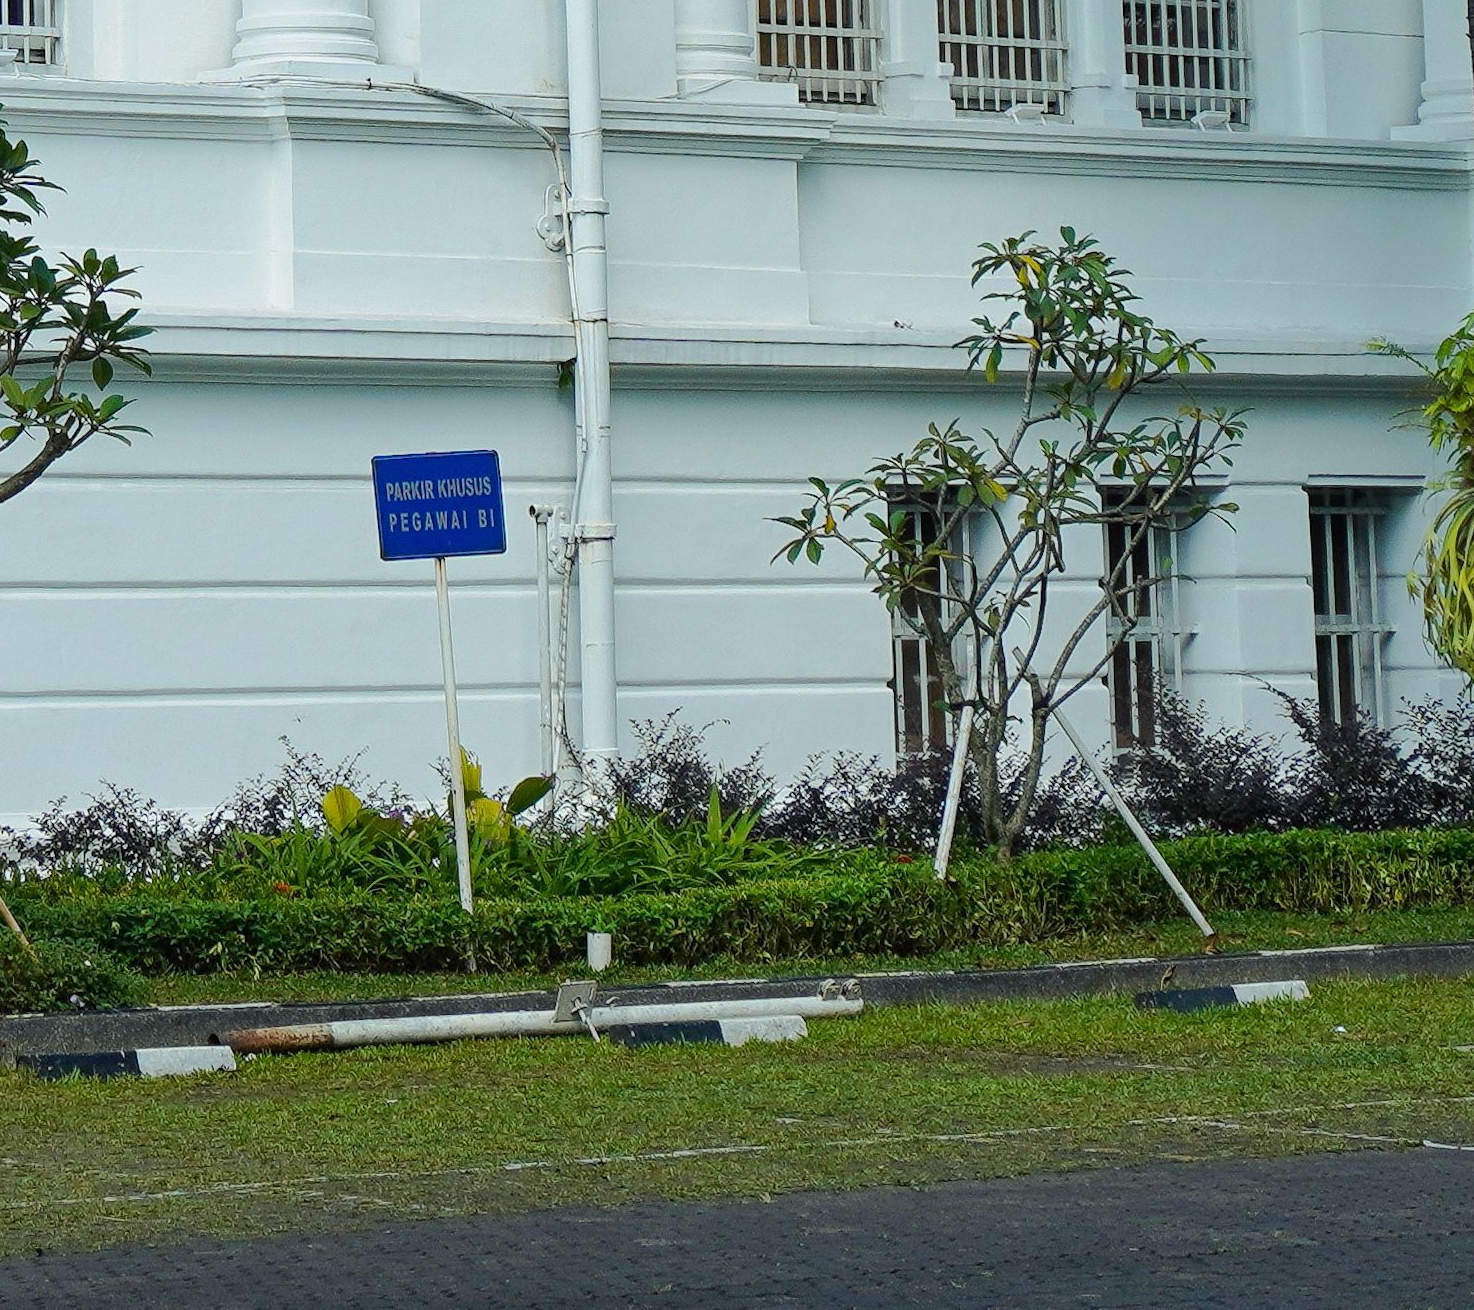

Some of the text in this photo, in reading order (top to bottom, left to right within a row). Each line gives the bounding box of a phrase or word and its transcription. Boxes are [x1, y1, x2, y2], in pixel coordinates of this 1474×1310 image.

[386, 476, 492, 502] PARKIR KHUSUS
[389, 508, 495, 532] PEGAWAI BI
